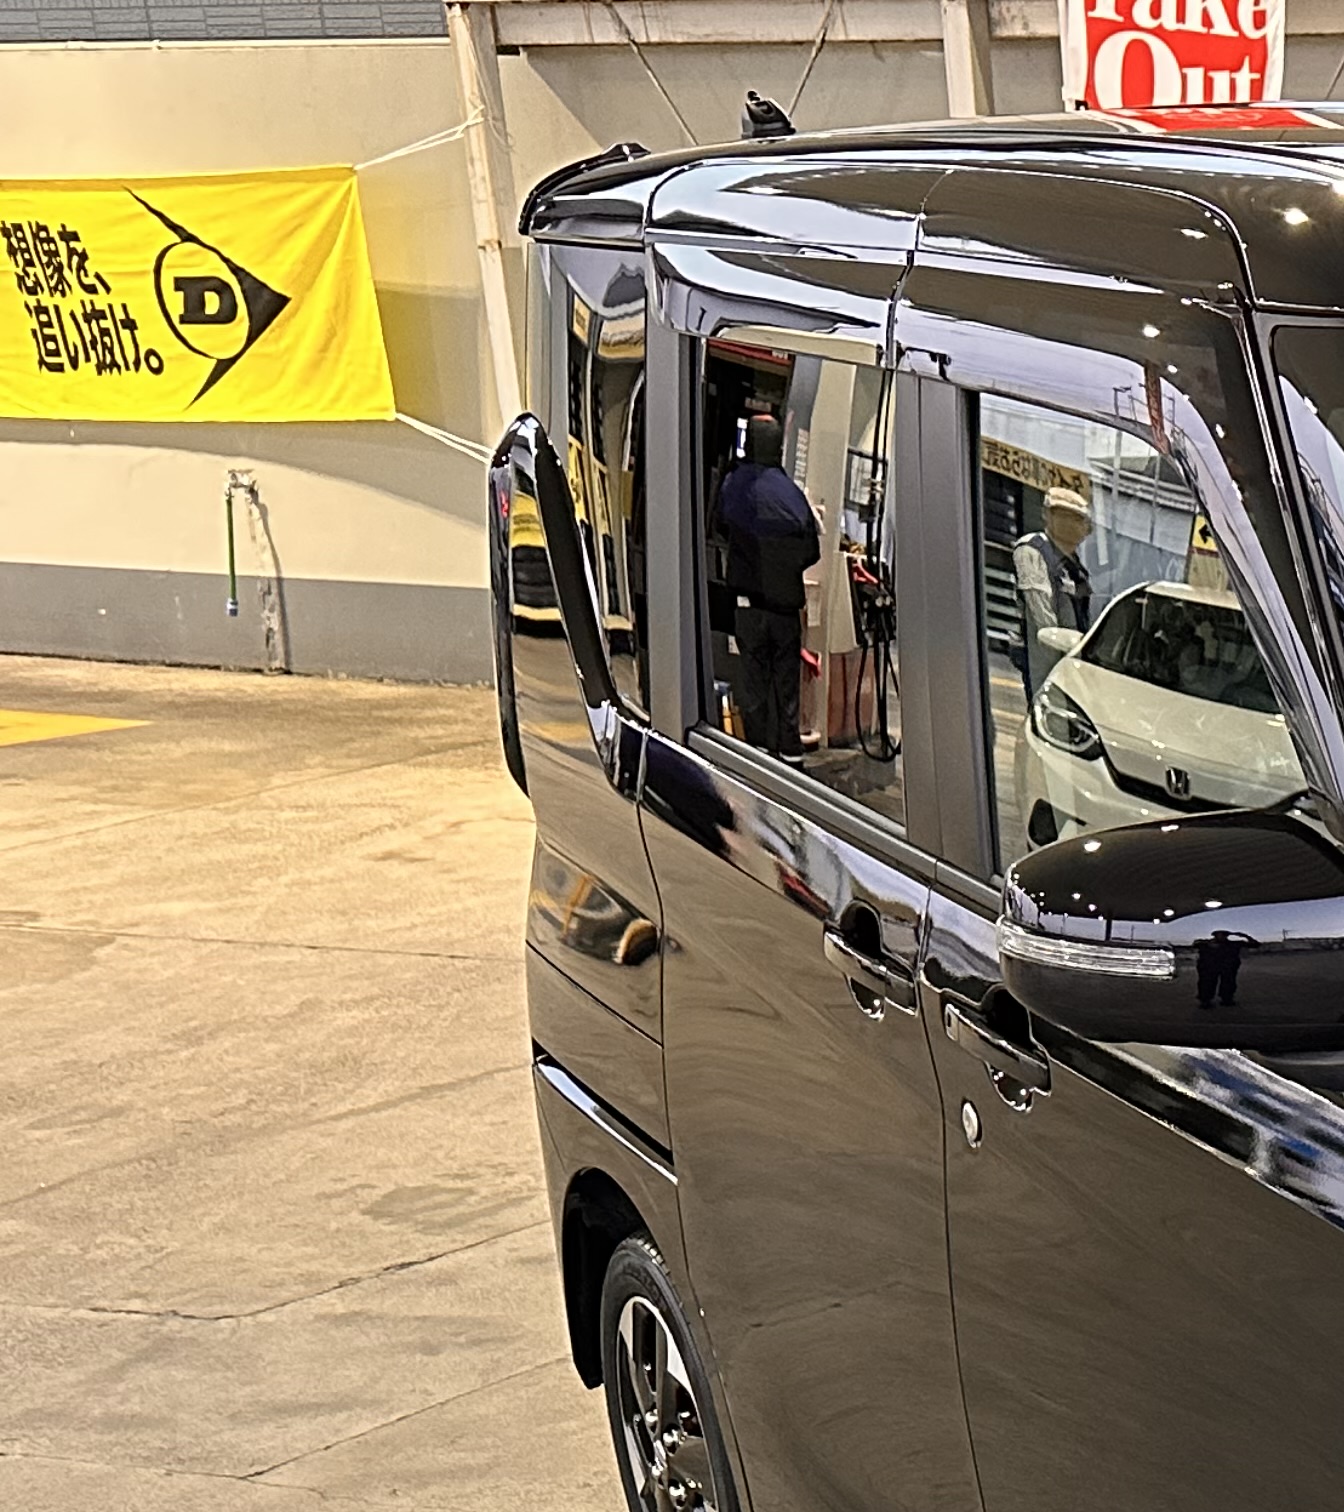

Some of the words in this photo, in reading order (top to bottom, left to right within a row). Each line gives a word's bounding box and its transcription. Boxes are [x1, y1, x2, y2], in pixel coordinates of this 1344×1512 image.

[1094, 30, 1261, 109] Out
[0, 221, 111, 297] 想像を、
[24, 298, 164, 376] 追い抜け。
